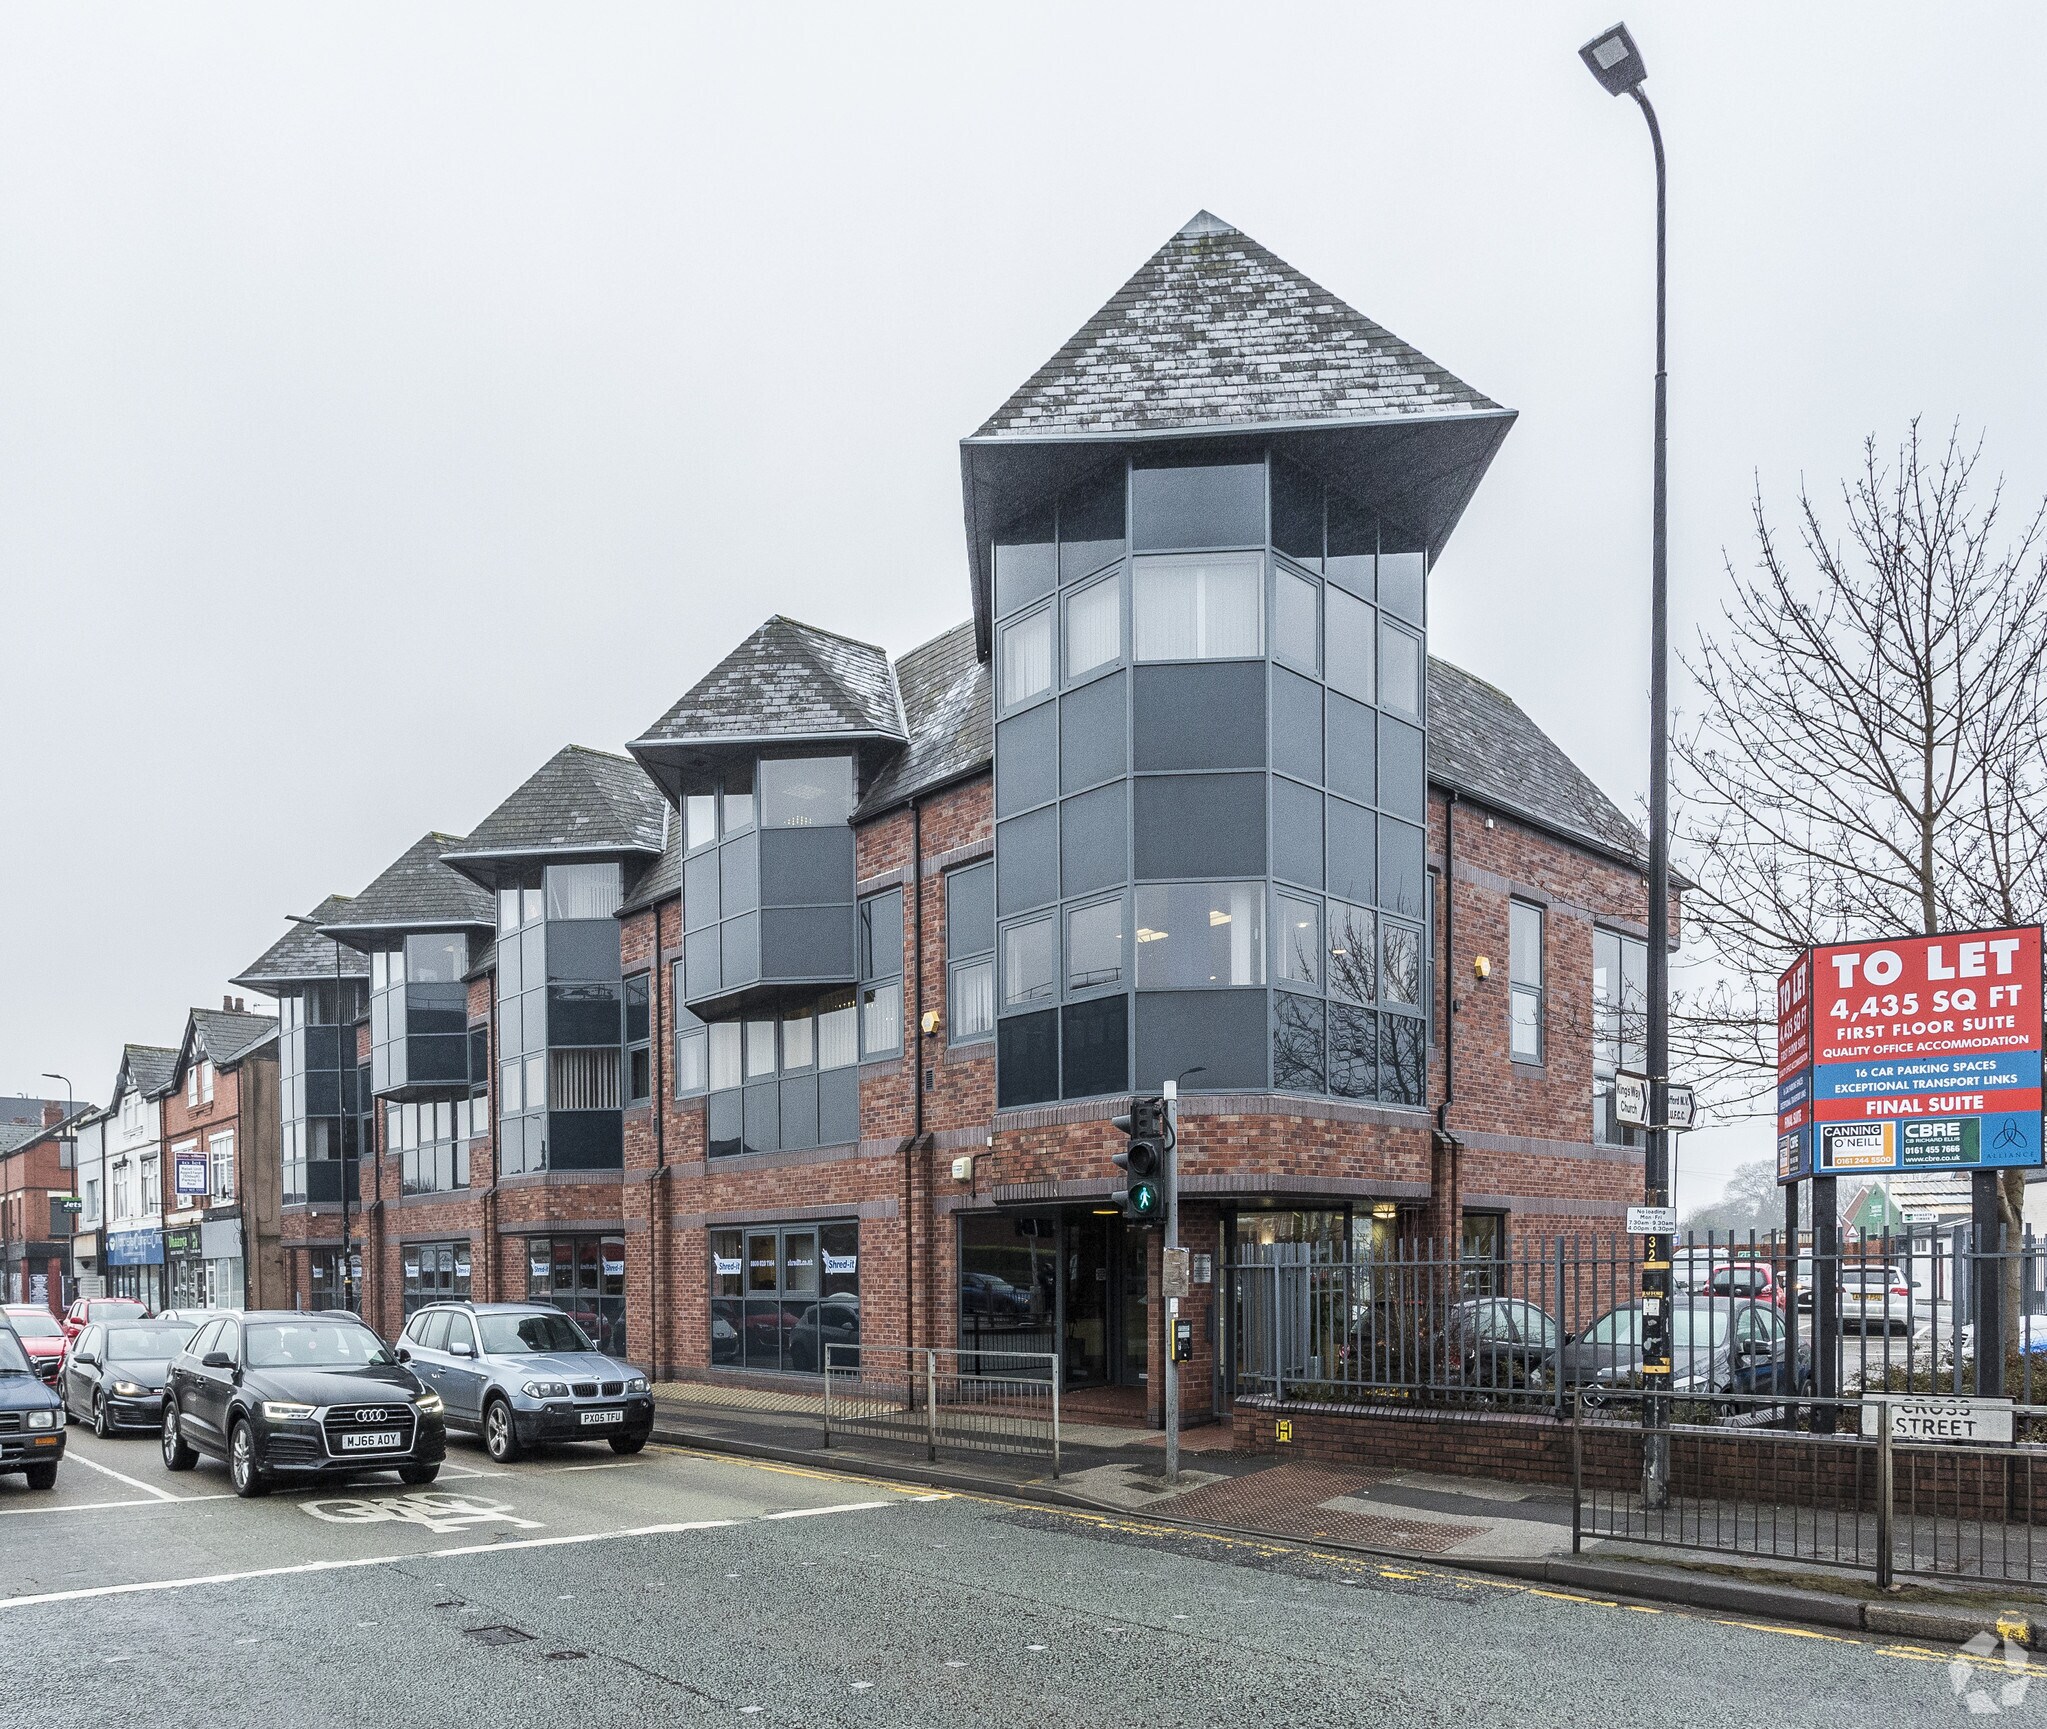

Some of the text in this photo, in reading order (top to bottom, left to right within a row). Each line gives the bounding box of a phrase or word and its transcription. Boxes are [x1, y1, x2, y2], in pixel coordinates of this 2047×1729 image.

[1832, 938, 2020, 989] TO LET
[1780, 961, 1806, 1016] TO LET
[1829, 984, 2022, 1022] 4,435 SQ FT
[1837, 1015, 2015, 1040] FIRST FLOOR SUITE
[1823, 1035, 2029, 1058] QUALITY OFFICE ACCOMMODATION
[1855, 1060, 1997, 1078] 16 CAR PARKING SPACES
[1834, 1074, 2018, 1094] EXCEPTIONAL TRANSPORT LINKS
[1620, 1101, 1638, 1114] Church
[1866, 1095, 1984, 1115] FINAL SUITE
[1824, 1125, 1880, 1136] CANNING
[1905, 1122, 1960, 1137] CBRE
[1834, 1137, 1881, 1147] O'NEILL
[1905, 1146, 1923, 1154] 0161
[1925, 1145, 1940, 1153] 455
[1987, 1151, 2034, 1159] ALLIANCE
[1836, 1157, 1853, 1165] 0161
[1905, 1154, 1960, 1163] www.cbre.co.uk
[719, 1262, 740, 1270] Shred-it
[829, 1259, 855, 1269] Shred-it
[1901, 1398, 1971, 1416] CROSS
[584, 1413, 621, 1422] PX05 TFU
[1896, 1417, 1977, 1436] STREET
[347, 1434, 397, 1447] MJ66 AOY
